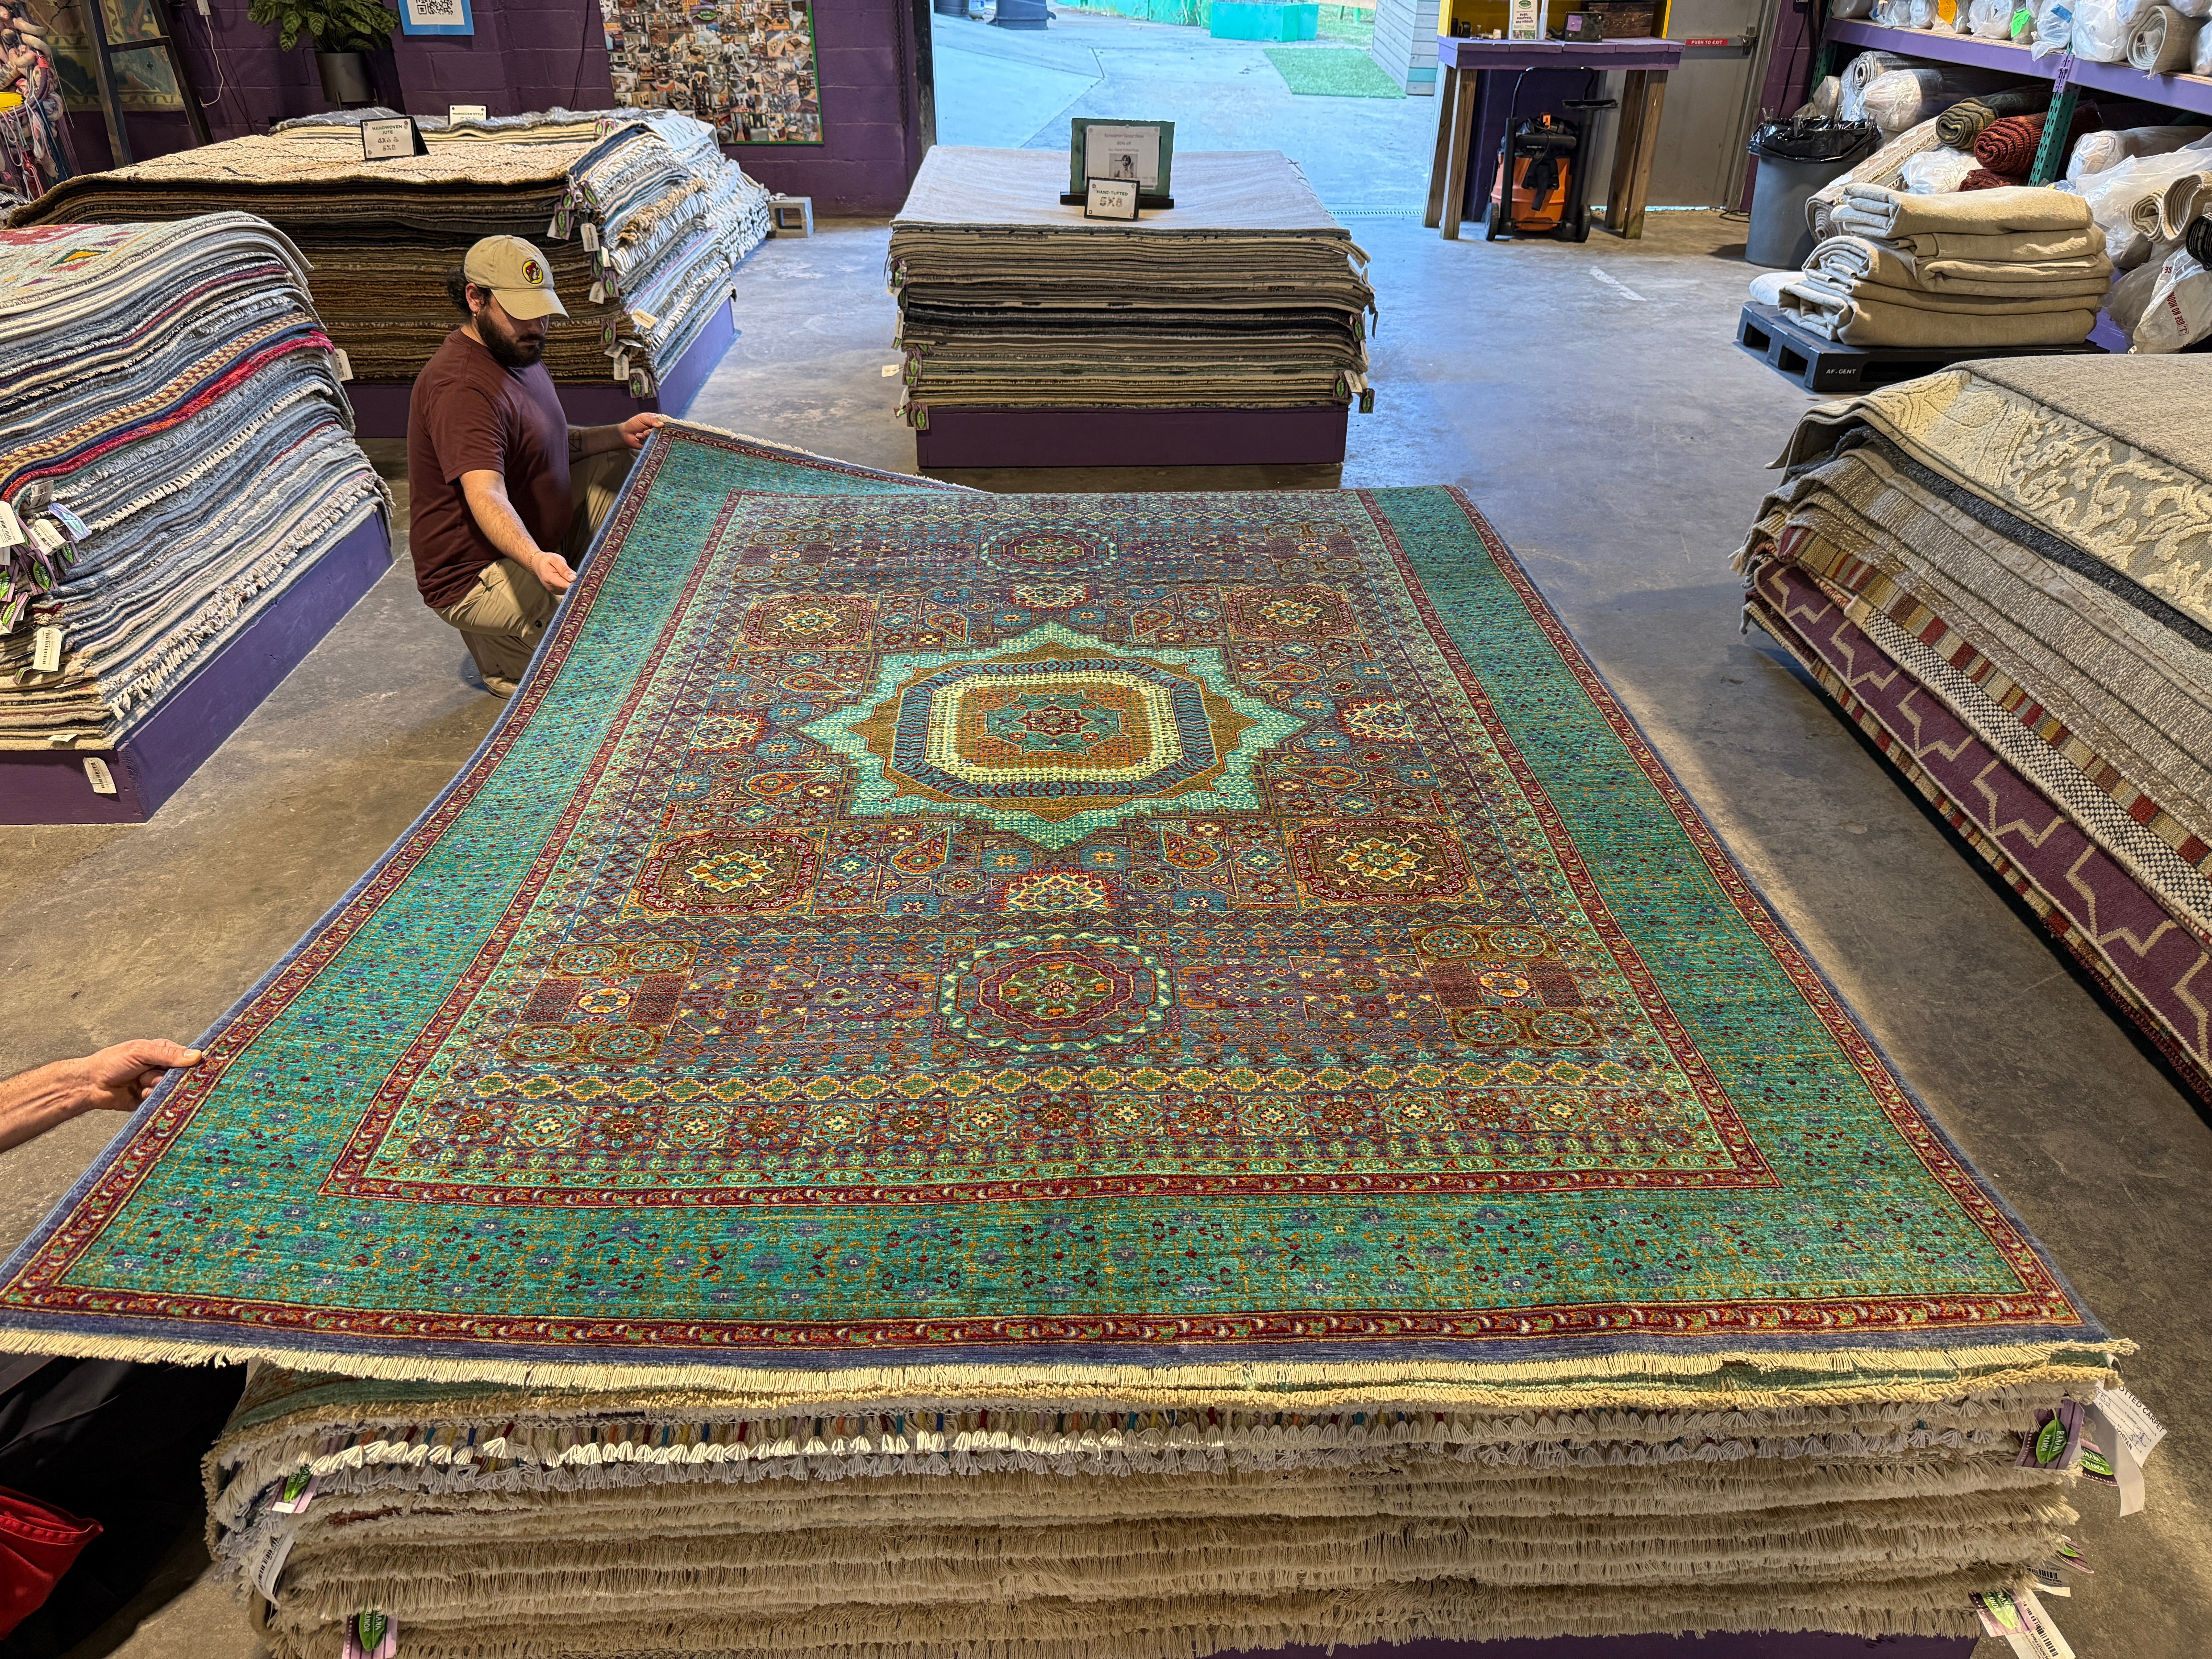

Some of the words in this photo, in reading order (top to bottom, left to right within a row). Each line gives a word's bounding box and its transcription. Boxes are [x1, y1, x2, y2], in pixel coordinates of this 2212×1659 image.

[1099, 197, 1123, 208] 5X8
[2171, 307, 2181, 316] NO
[2174, 315, 2186, 326] USE
[2143, 1407, 2165, 1432] CARPET
[2040, 1434, 2051, 1452] MANOR
[2052, 1431, 2065, 1452] BANANA
[2085, 1460, 2106, 1472] MANOR
